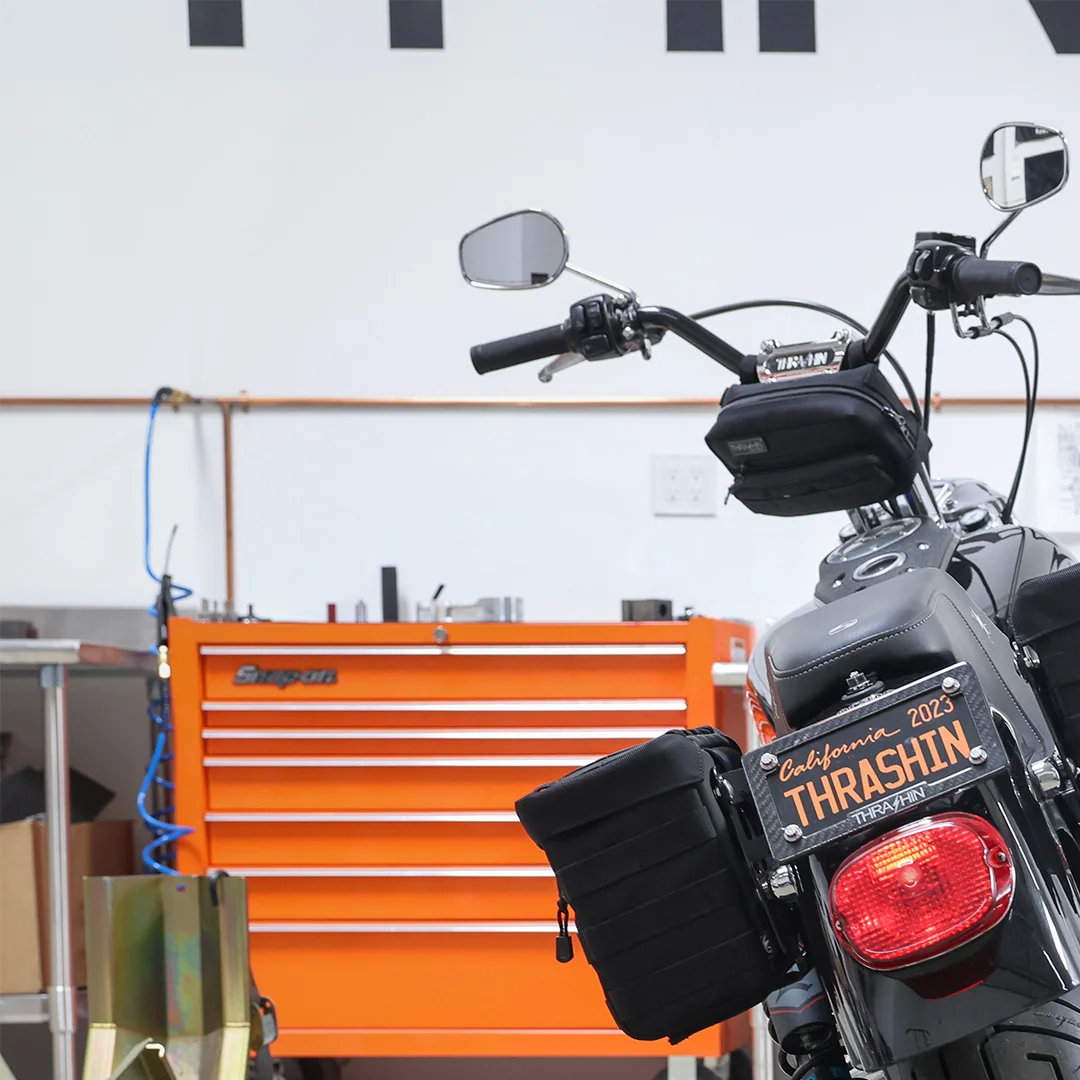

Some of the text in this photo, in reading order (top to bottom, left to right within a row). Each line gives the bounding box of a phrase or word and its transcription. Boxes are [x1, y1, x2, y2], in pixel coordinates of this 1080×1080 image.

[233, 664, 338, 689] Snap-on
[906, 694, 955, 728] 2023
[778, 727, 901, 783] California
[783, 719, 972, 828] THRASHIN
